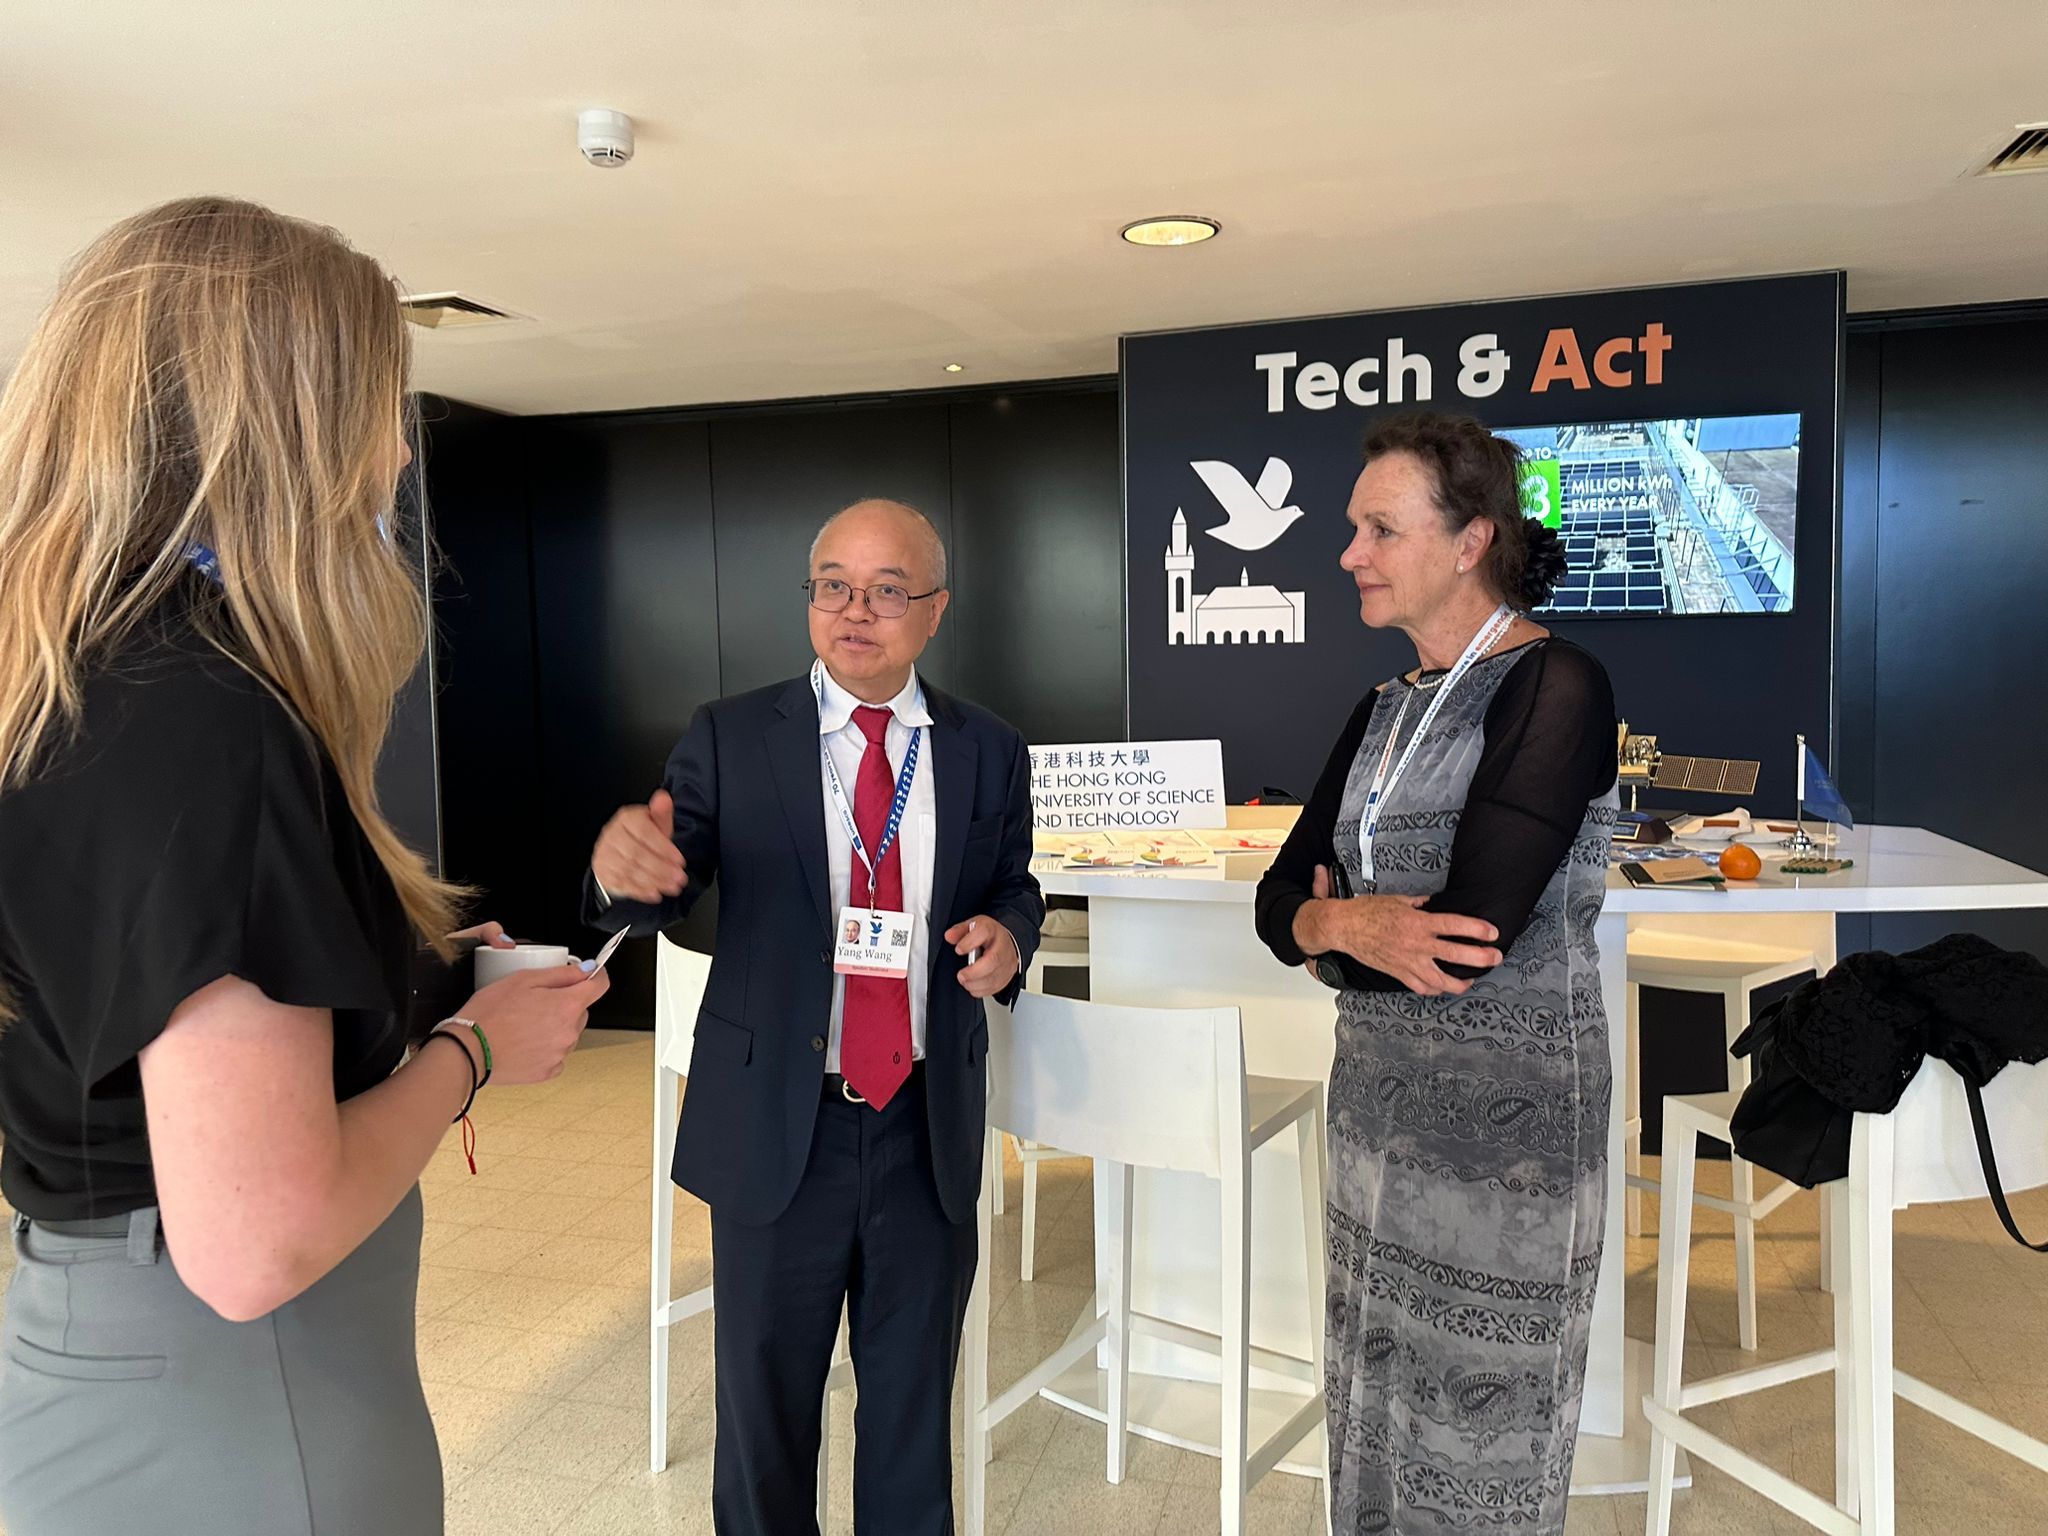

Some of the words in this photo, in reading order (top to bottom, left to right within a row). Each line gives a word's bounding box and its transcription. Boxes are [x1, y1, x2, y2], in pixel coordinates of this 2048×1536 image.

[1255, 338, 1432, 413] Tech
[1457, 333, 1511, 398] &
[1530, 322, 1673, 393] Act
[1536, 447, 1552, 460] TO
[1571, 477, 1634, 495] MILLION
[1638, 473, 1673, 490] kWh
[1522, 475, 1551, 521] 3
[1572, 497, 1615, 513] EVERY
[1617, 495, 1659, 511] YEAR
[1466, 651, 1477, 660] in
[1031, 774, 1051, 788] HE
[1057, 772, 1109, 788] HONG
[1115, 770, 1166, 786] KONG
[832, 784, 840, 796] 70
[1119, 791, 1141, 806] OF
[1147, 789, 1215, 804] SCIENCE
[1033, 813, 1062, 828] ND
[1066, 810, 1180, 828] TECHNOLOGY
[838, 946, 862, 960] Yang
[865, 949, 892, 962] Wang
